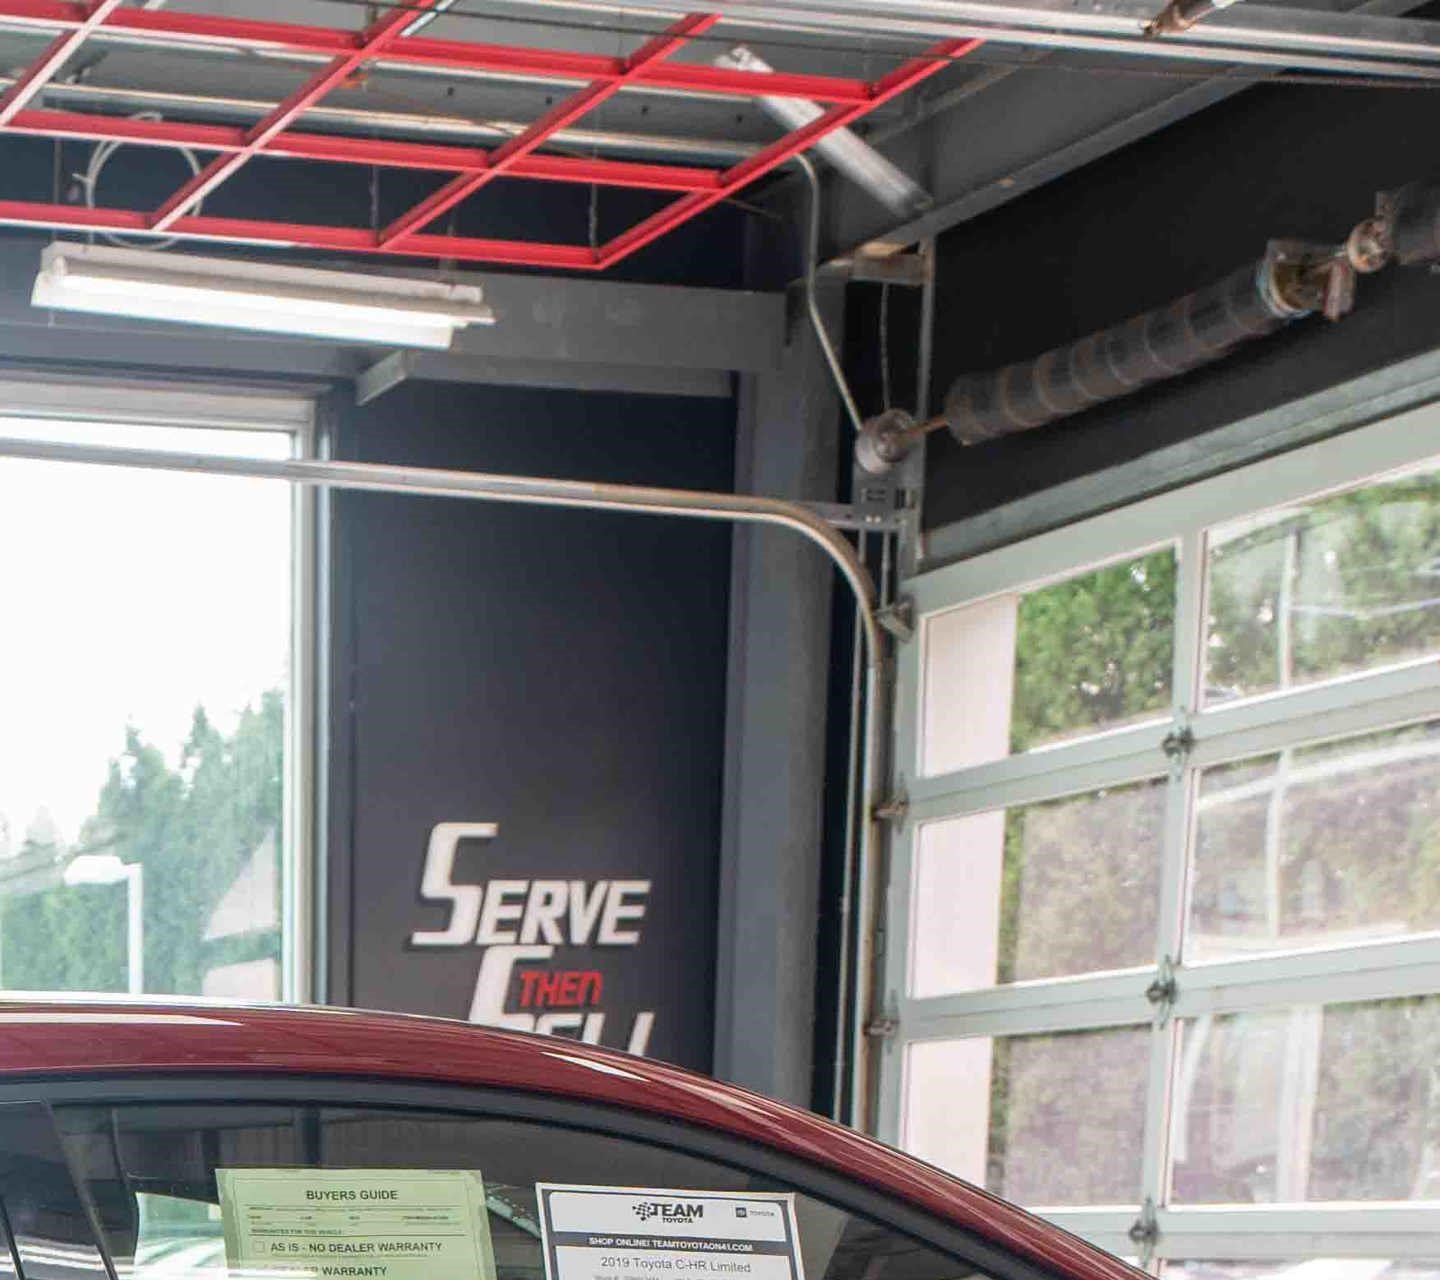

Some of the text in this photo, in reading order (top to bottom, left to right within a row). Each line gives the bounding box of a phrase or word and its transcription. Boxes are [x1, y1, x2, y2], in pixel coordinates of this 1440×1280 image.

[411, 821, 651, 945] SERVE
[520, 970, 603, 1008] THEN
[306, 1190, 398, 1201] BUYERS GUIDE
[650, 1203, 703, 1218] TEAM
[271, 1242, 285, 1251] AS
[289, 1242, 299, 1252] IS
[309, 1243, 326, 1252] NO
[328, 1243, 375, 1253] DEALER
[378, 1242, 442, 1252] WARRANTY
[588, 1237, 614, 1246] SHOP
[615, 1238, 650, 1247] ONLINE!
[322, 1266, 387, 1276] WARRANTY
[601, 1257, 751, 1273] 2019 Toyota C-HR Limited
